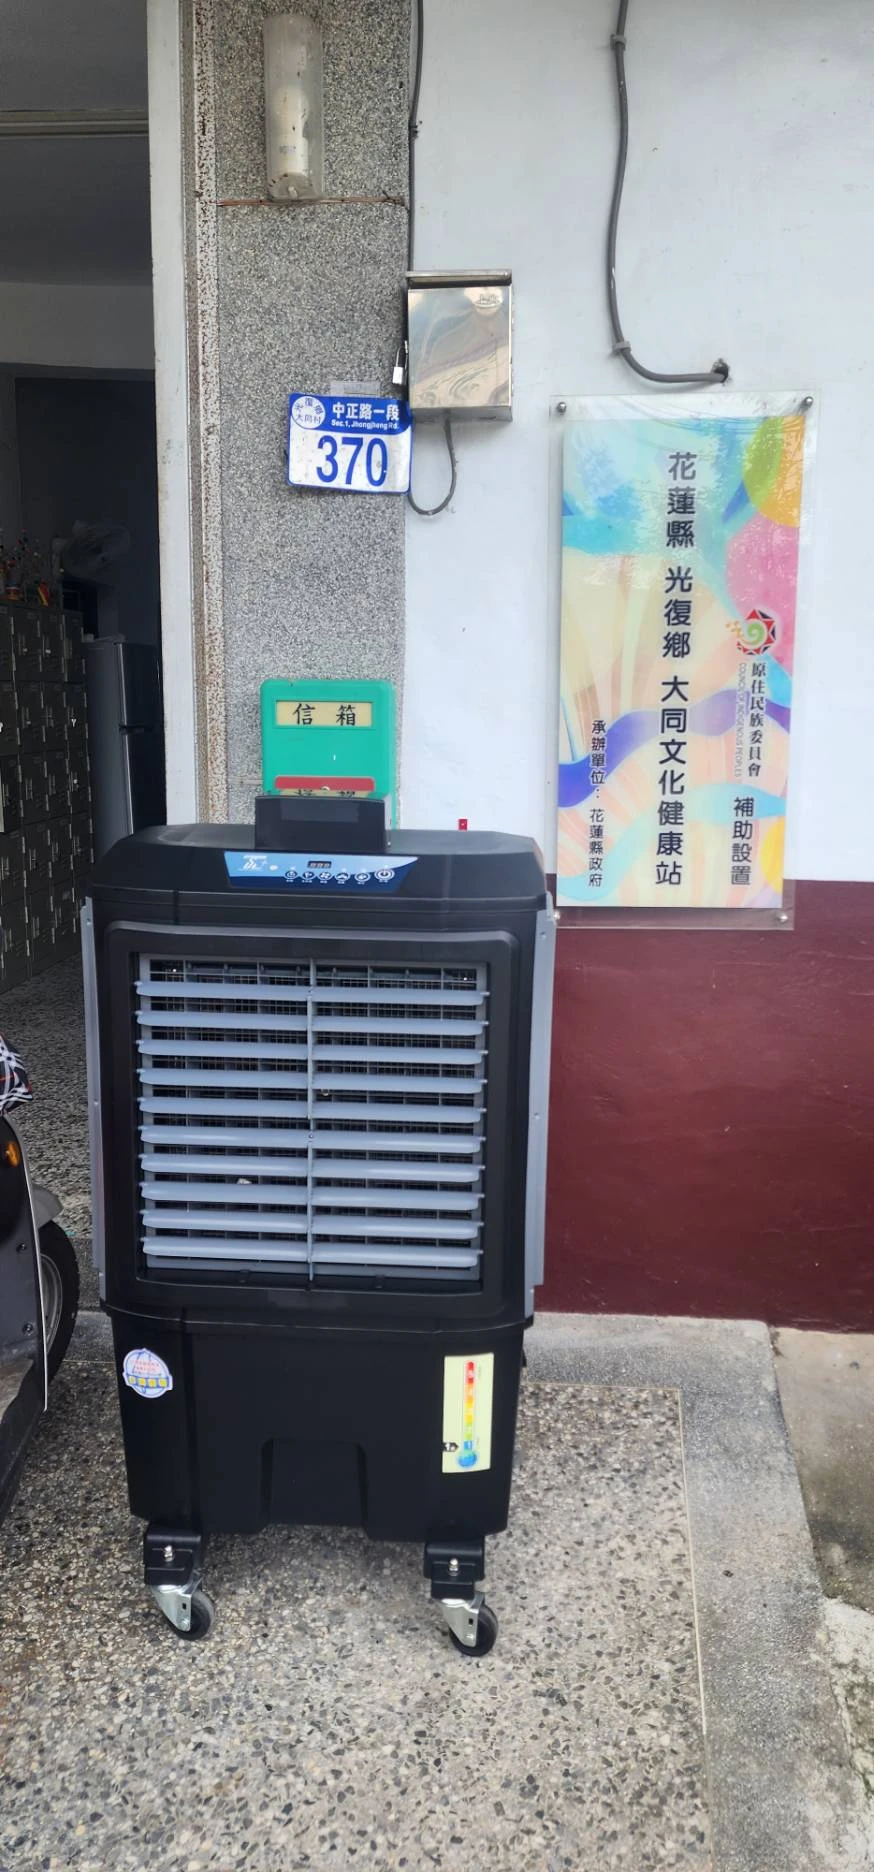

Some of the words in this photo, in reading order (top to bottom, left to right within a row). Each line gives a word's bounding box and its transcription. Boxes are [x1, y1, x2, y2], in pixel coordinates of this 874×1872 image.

[332, 402, 399, 421] 中正路一段
[316, 435, 388, 487] 370
[666, 452, 698, 548] 花蓮縣
[662, 566, 693, 658] 光復鄉
[292, 703, 356, 726] 信箱
[748, 662, 766, 777] 原住民族委員會
[655, 675, 690, 885] 大同文化健康站
[588, 808, 604, 887] 花蓮縣政府
[731, 796, 755, 885] 補助設置
